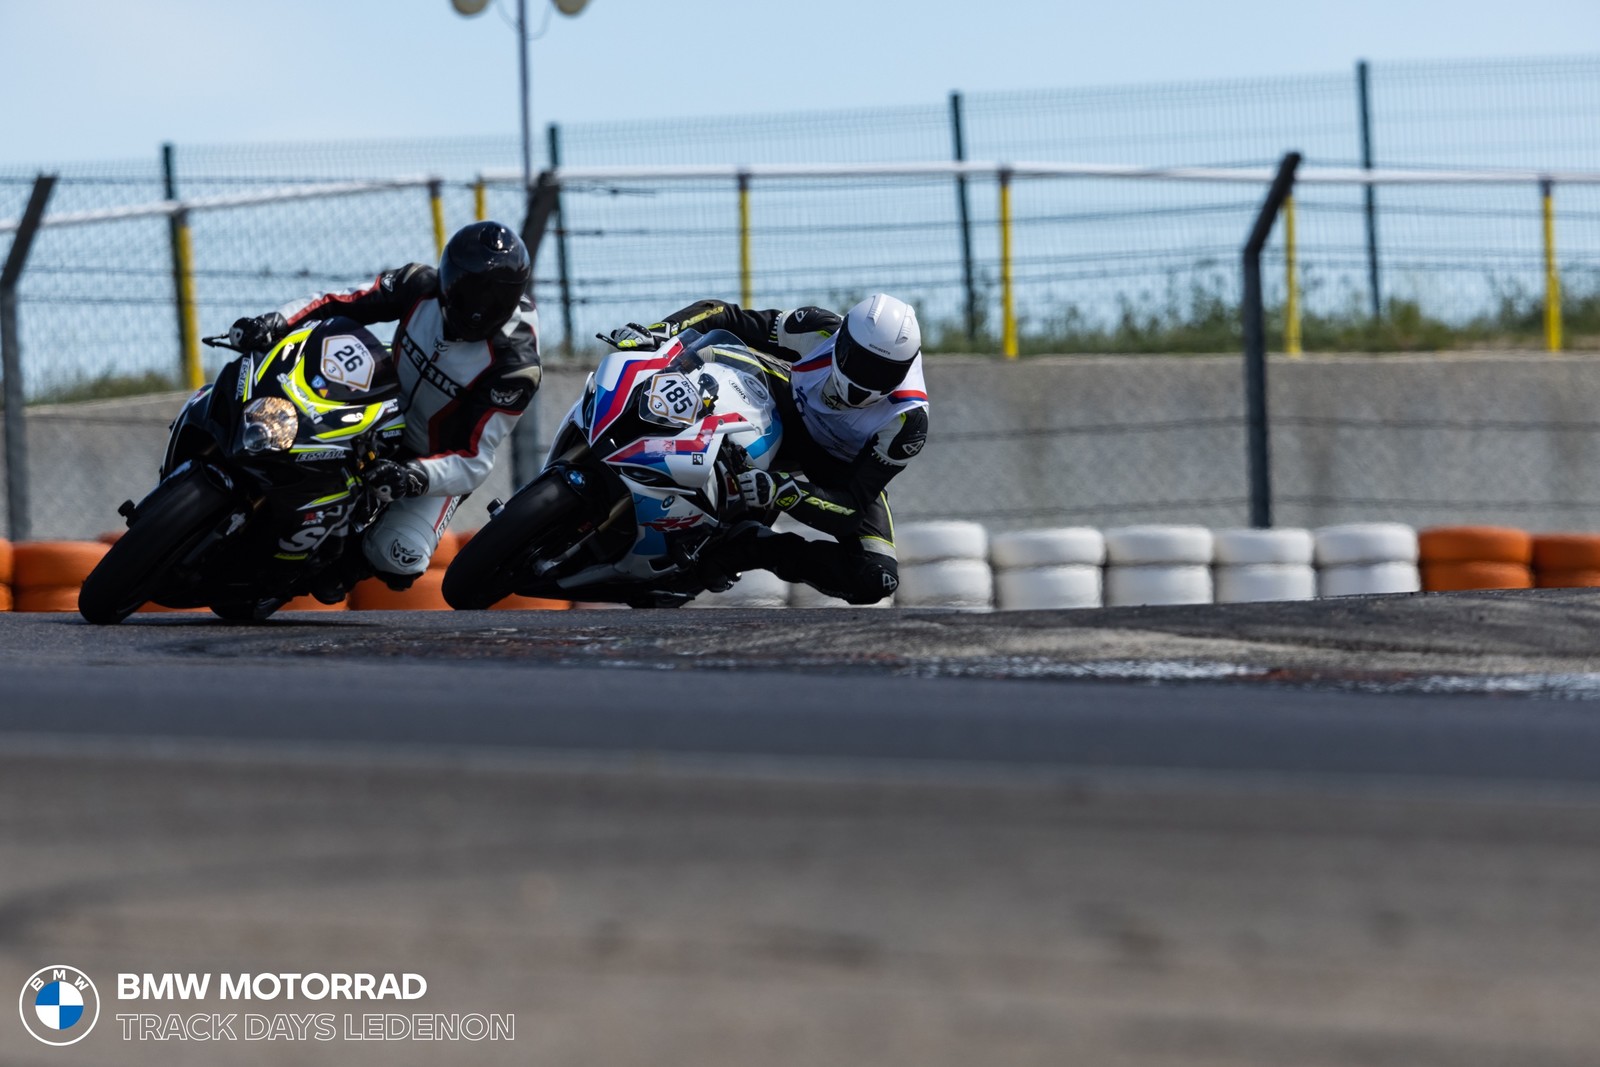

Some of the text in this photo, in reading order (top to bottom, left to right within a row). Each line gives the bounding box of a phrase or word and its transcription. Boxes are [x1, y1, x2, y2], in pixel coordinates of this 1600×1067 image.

[334, 345, 363, 372] 26
[329, 366, 336, 374] 3
[654, 401, 663, 409] 3
[660, 379, 693, 414] 185
